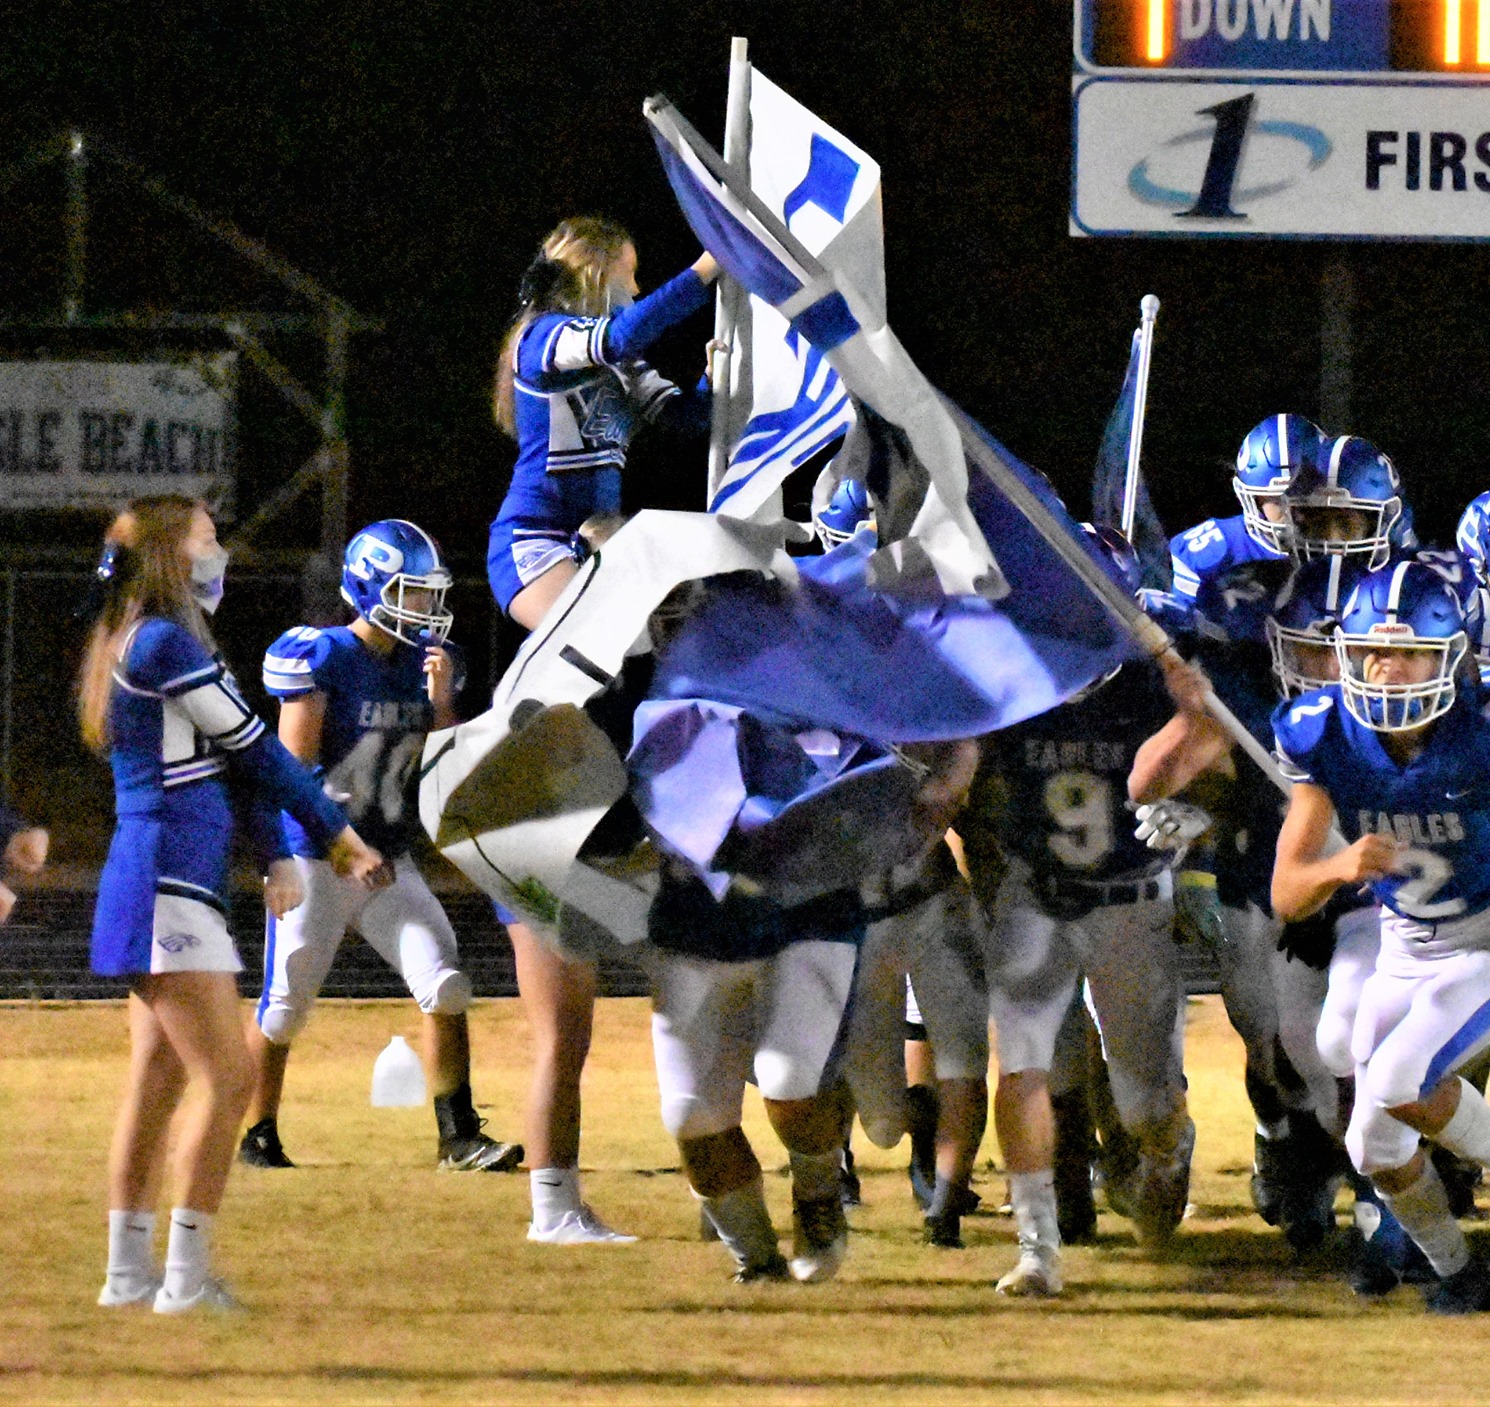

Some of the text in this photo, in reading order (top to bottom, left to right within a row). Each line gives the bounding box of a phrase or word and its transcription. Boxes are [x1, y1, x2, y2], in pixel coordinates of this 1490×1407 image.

[1178, 0, 1331, 42] DOWN
[1043, 770, 1117, 870] 9
[1357, 808, 1466, 845] EAGLES
[1394, 848, 1469, 919] 2
